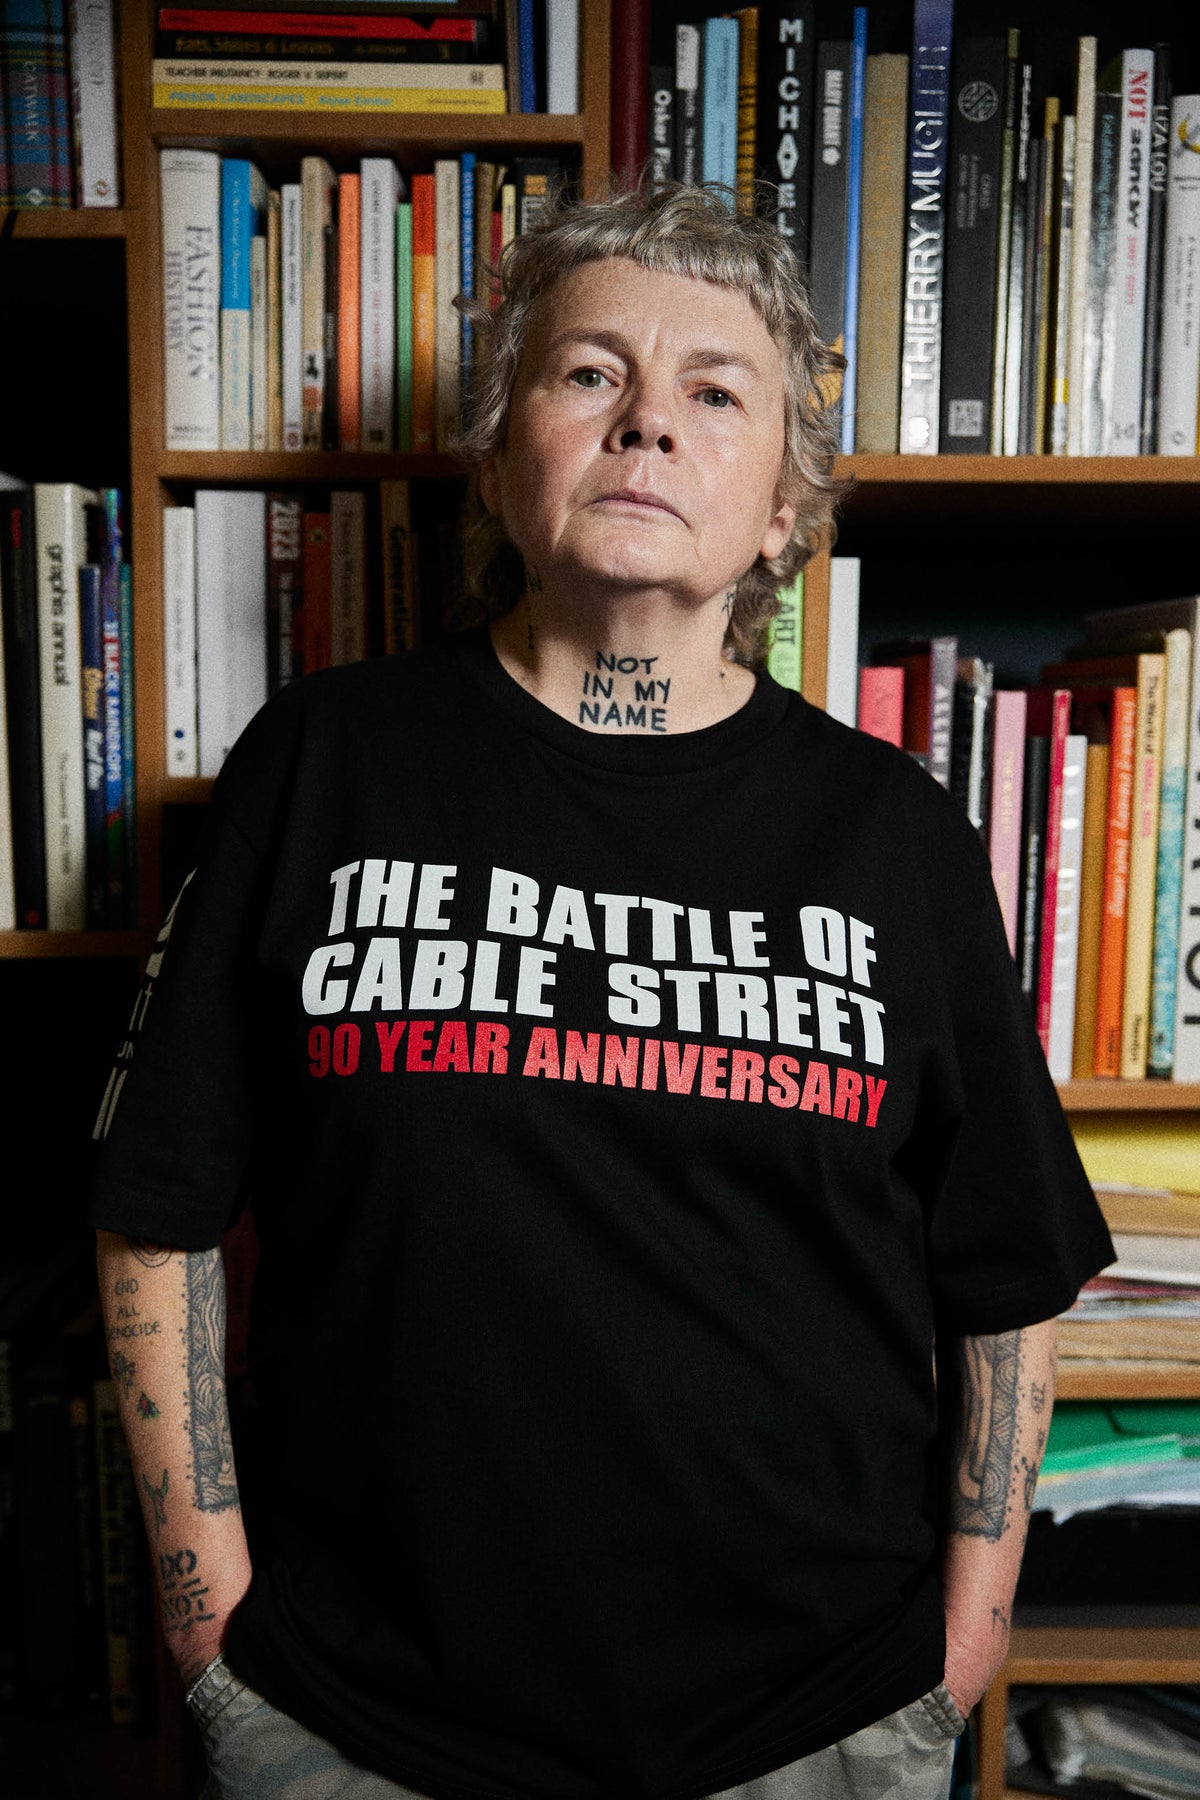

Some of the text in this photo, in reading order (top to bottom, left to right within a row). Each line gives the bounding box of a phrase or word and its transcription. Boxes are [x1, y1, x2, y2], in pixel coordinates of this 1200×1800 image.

[25, 61, 39, 143] CATWALK
[165, 67, 207, 78] TEACHER
[210, 68, 260, 79] MILITANCY
[169, 91, 216, 103] PRISON
[221, 92, 306, 105] LANDSCAPES
[823, 69, 843, 146] MARY QUANT
[1127, 68, 1149, 123] NOT
[653, 89, 672, 144] Oskar
[1149, 104, 1170, 193] LIZA LOU
[166, 250, 184, 352] HISTORY
[185, 225, 214, 379] FASHION
[905, 222, 942, 387] THIERRY
[270, 500, 300, 561] 2023
[46, 544, 71, 687] graphis annual
[388, 526, 409, 653] Generation
[104, 643, 119, 692] BLACK
[582, 671, 671, 704] IN MY
[596, 650, 658, 675] NOT
[106, 694, 121, 782] RAINDROPS
[578, 701, 668, 733] NAME
[327, 859, 877, 987] THE BATTLE OF
[301, 937, 886, 1066] CABLE STREET
[307, 1021, 888, 1128] 90 YEAR ANNIVERSARY
[114, 1278, 139, 1296] END
[117, 1305, 141, 1320] ALL
